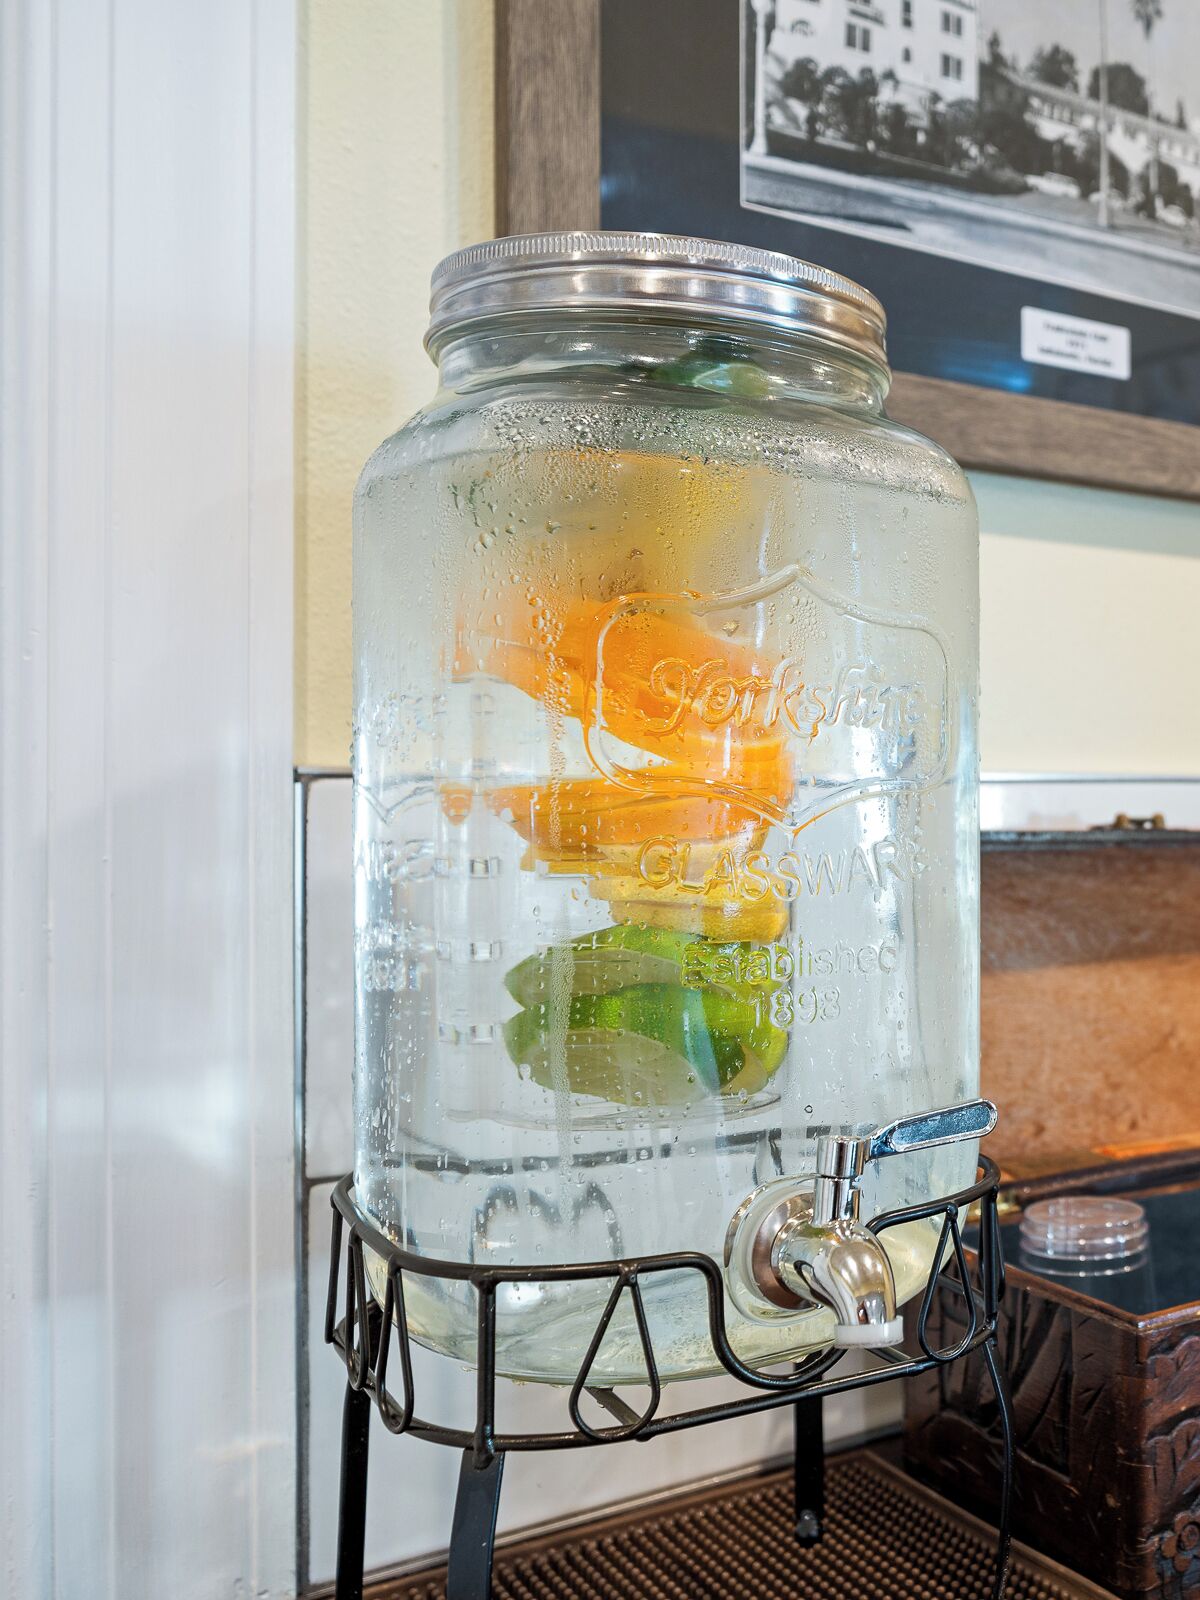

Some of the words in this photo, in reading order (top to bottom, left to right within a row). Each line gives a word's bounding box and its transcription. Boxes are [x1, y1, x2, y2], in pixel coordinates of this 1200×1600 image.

[639, 836, 928, 901] GLASSWARE
[681, 938, 897, 988] Established
[752, 985, 841, 1029] 1898
